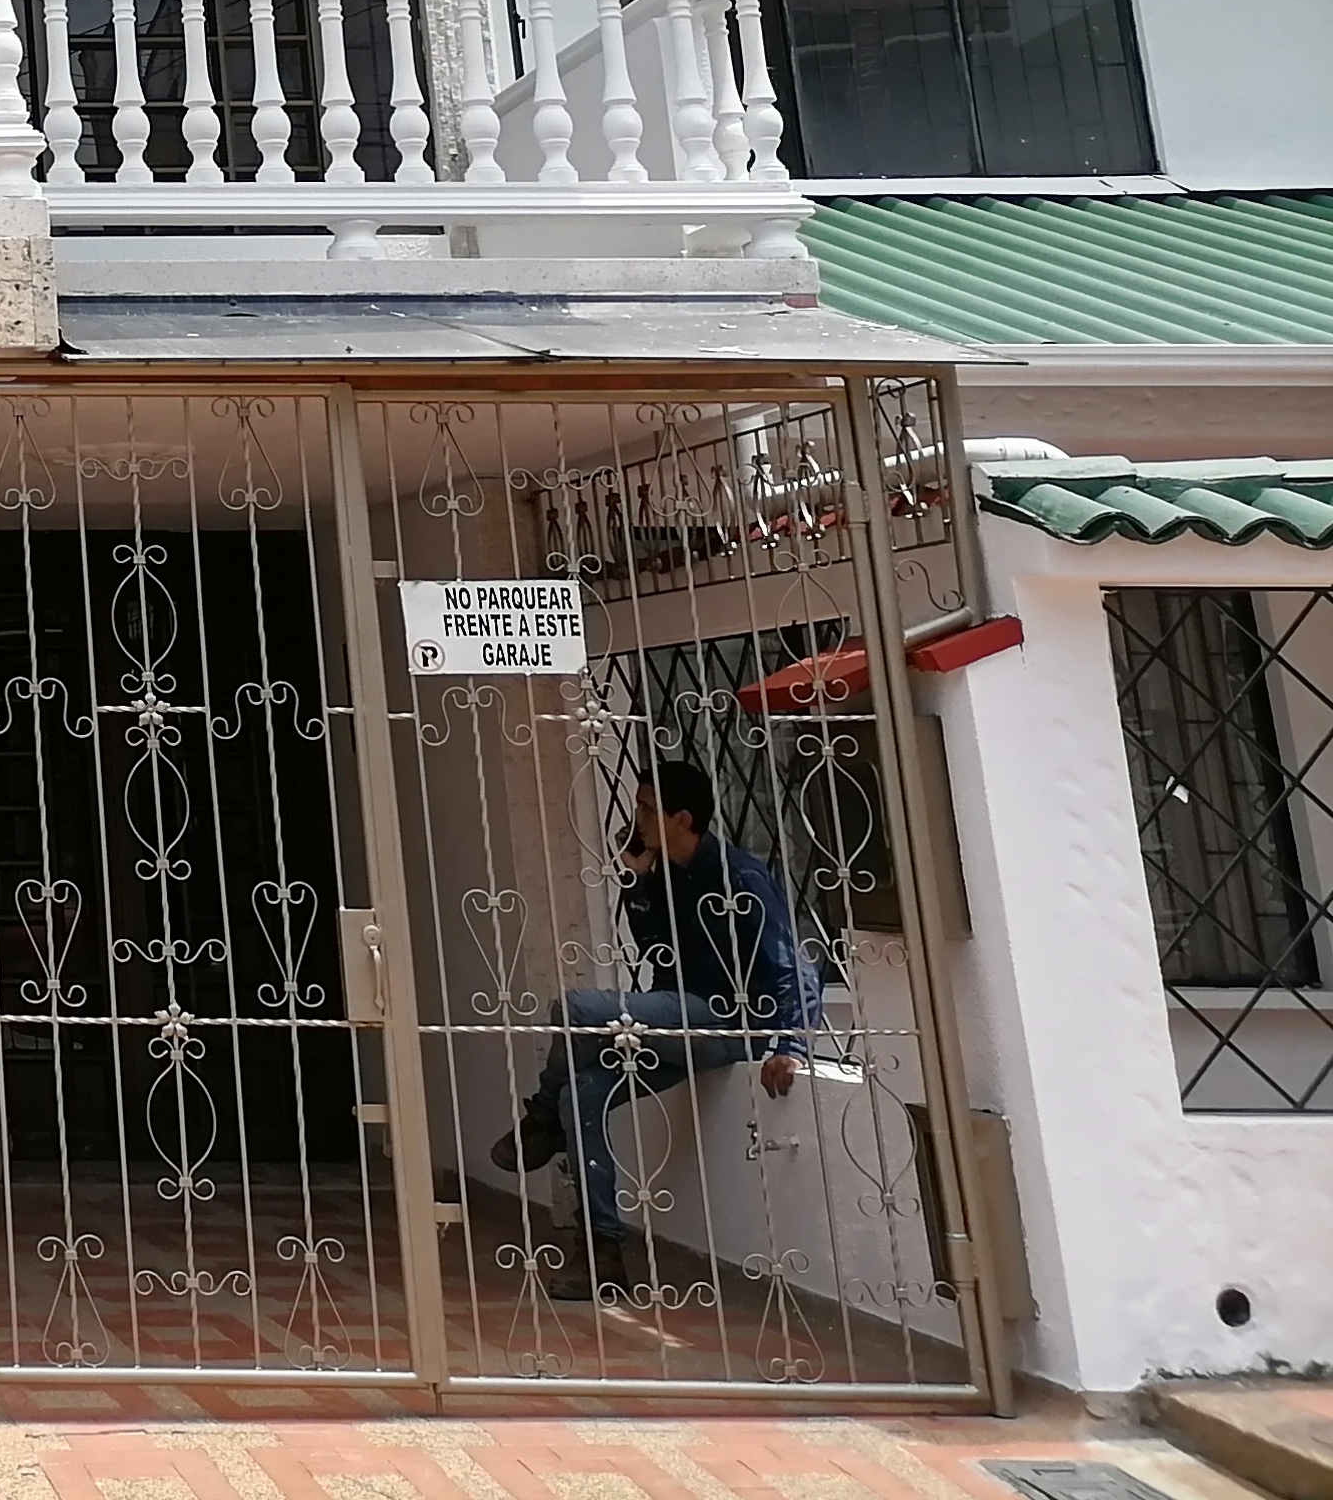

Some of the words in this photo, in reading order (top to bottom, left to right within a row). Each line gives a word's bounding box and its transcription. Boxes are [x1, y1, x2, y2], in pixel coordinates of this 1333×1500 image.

[444, 588, 471, 609] NO
[477, 587, 573, 610] PARQUEAR
[443, 614, 514, 636] FRENTE
[519, 614, 531, 636] A
[535, 614, 581, 636] ESTE
[482, 643, 552, 666] GARAJE
